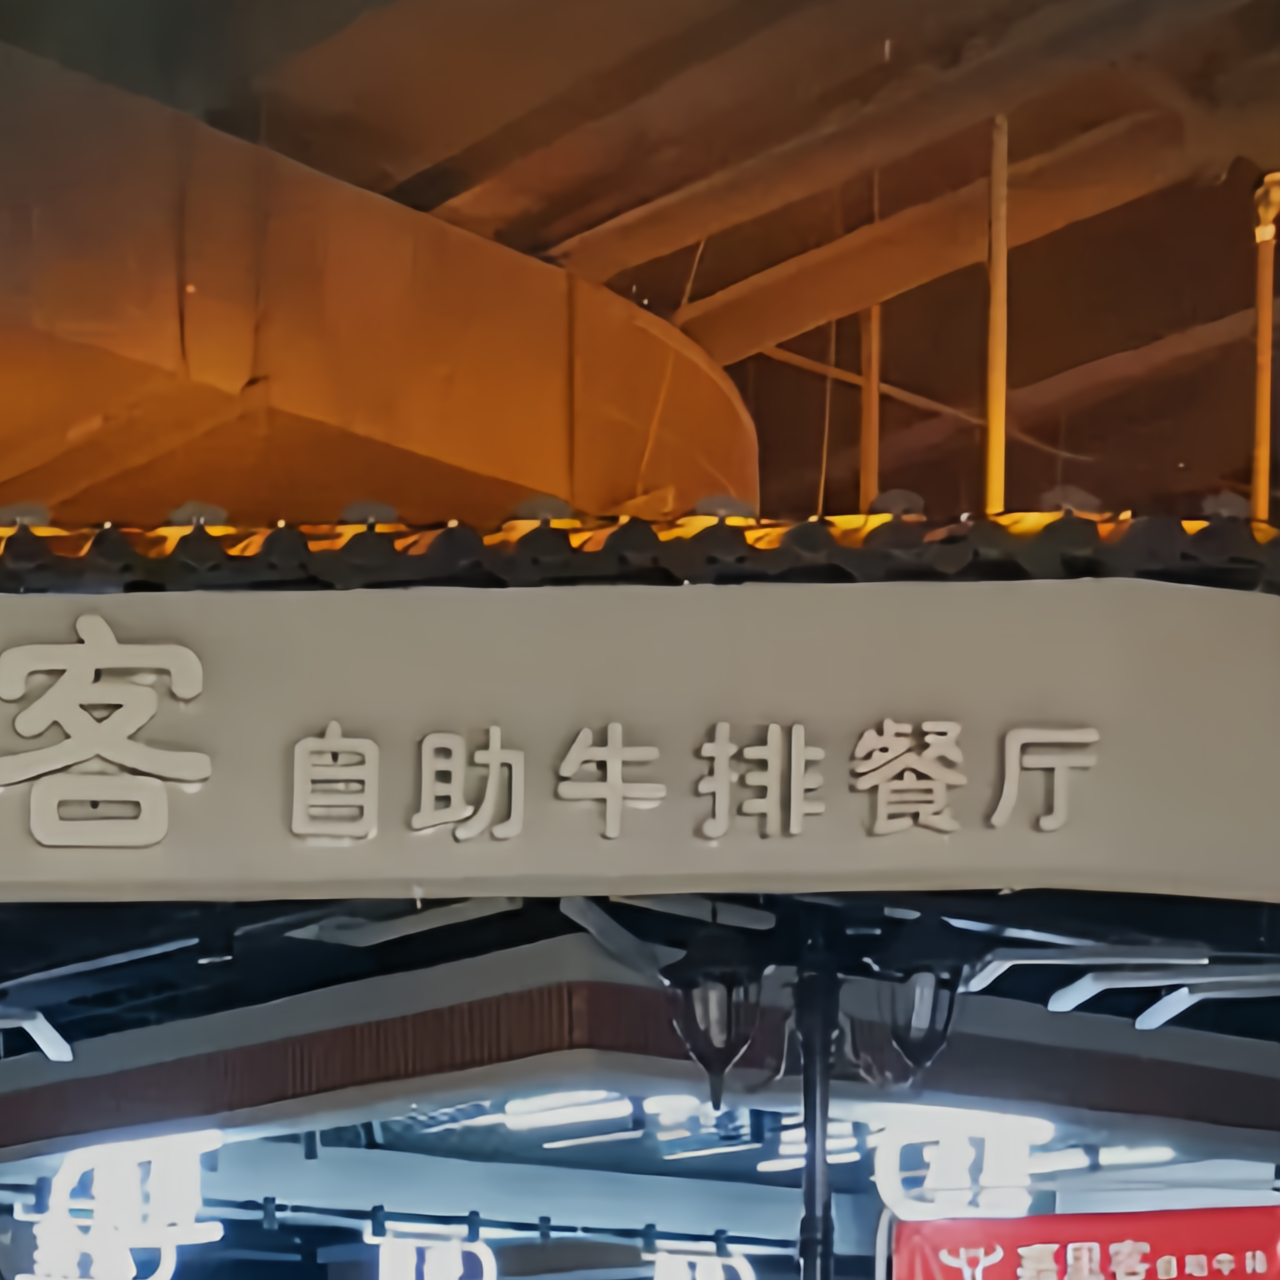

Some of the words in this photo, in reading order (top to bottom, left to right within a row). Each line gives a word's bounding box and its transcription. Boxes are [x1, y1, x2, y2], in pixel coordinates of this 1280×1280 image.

[291, 718, 1101, 845] 自助牛排餐厅
